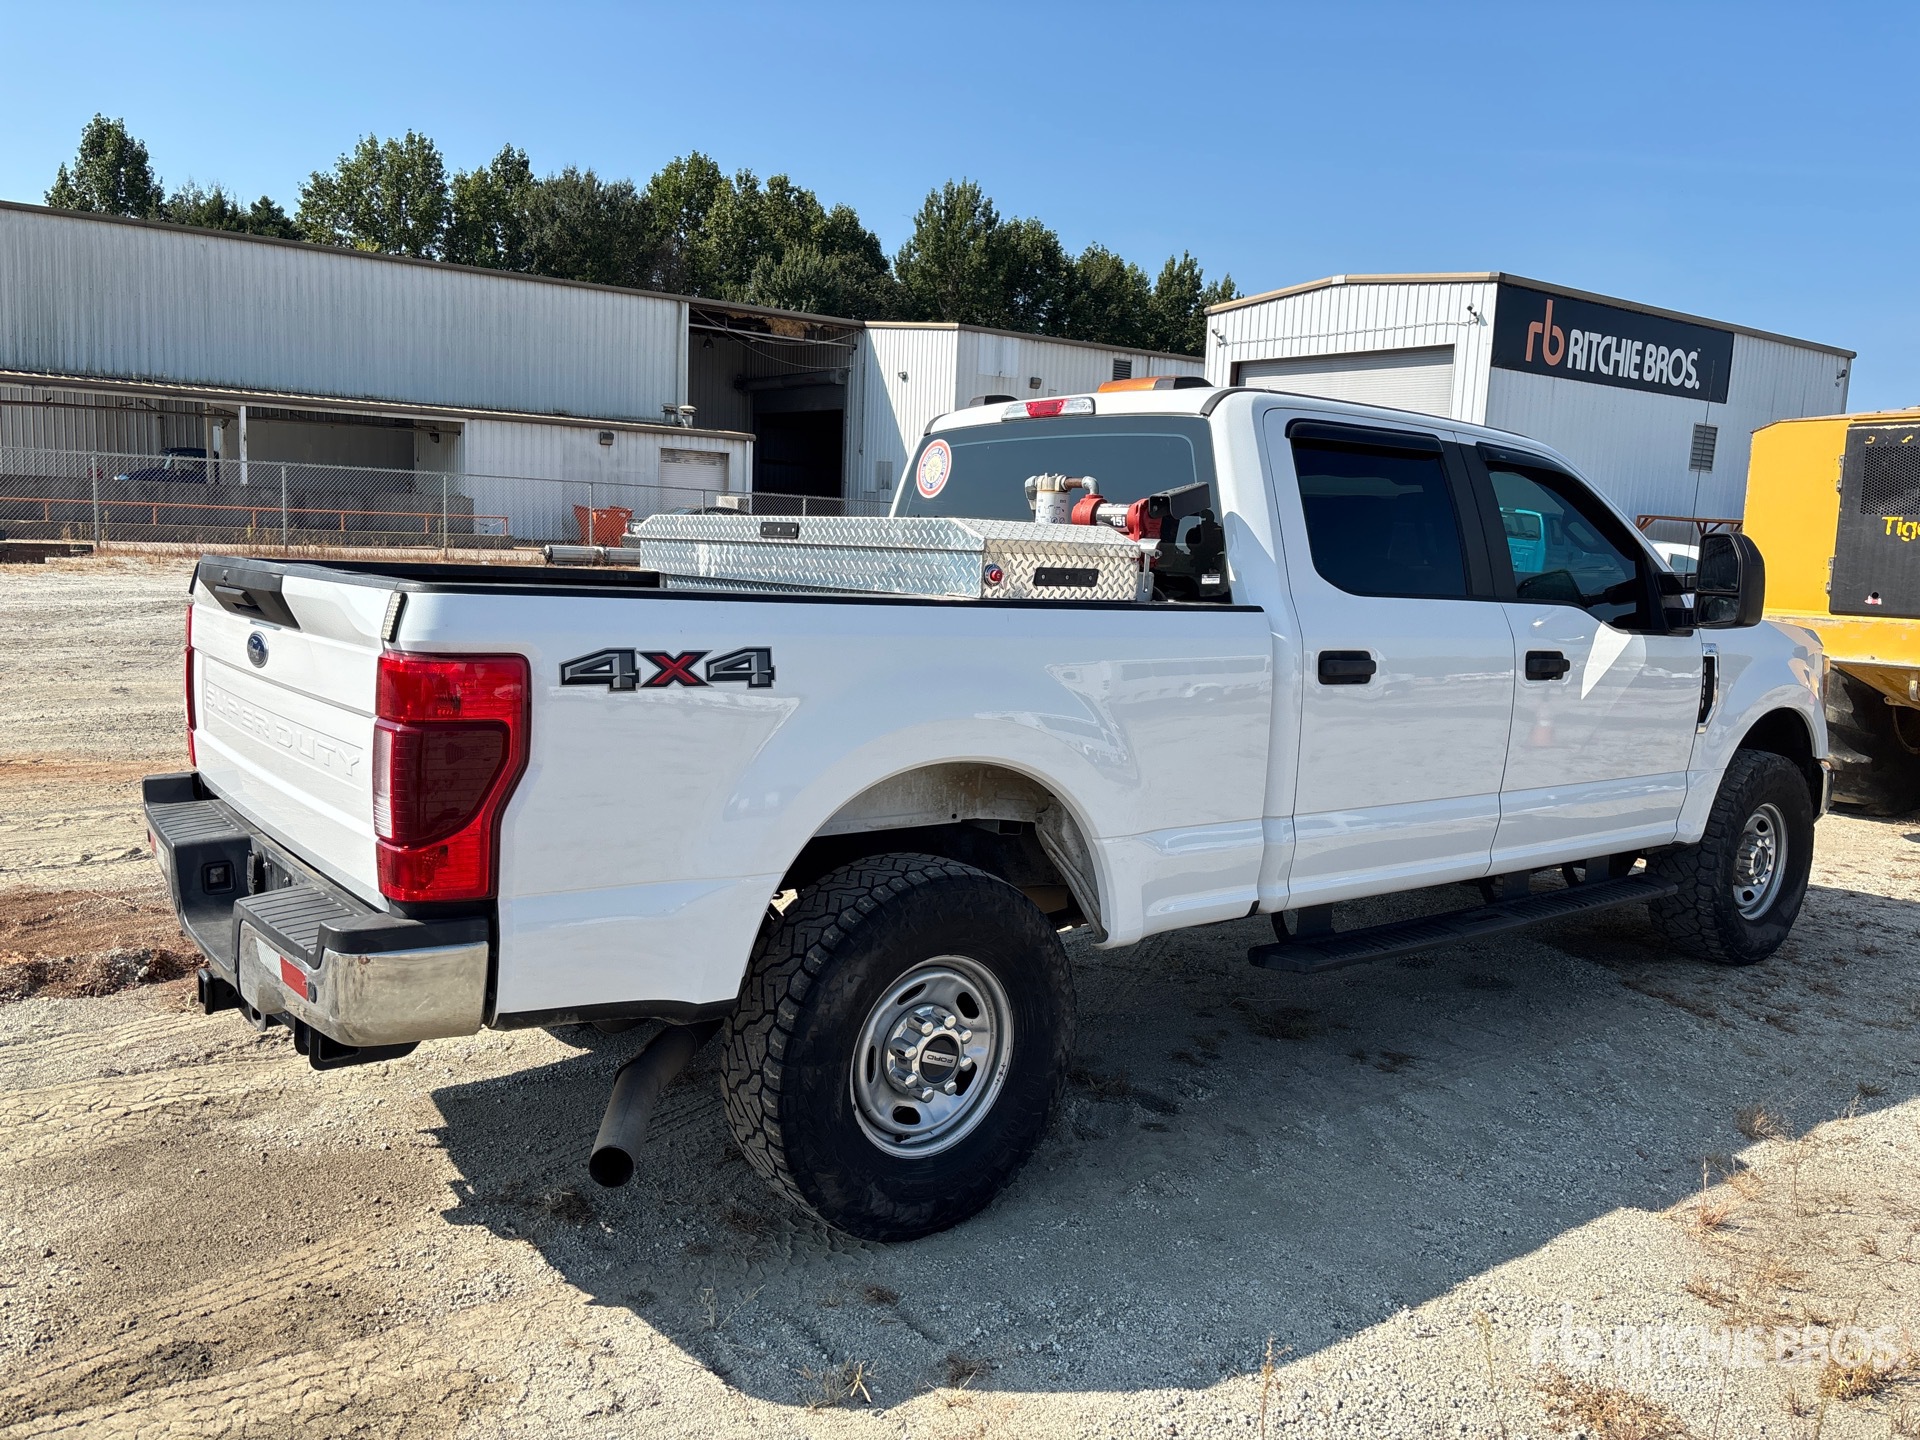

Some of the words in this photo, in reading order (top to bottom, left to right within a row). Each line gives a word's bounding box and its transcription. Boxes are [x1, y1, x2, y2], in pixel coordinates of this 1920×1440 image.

[1525, 299, 1565, 366] rb
[1567, 328, 1643, 380] RITCHIE
[1643, 343, 1700, 390] BROS.
[1110, 516, 1123, 527] 15
[206, 685, 270, 739] SUPER
[275, 722, 360, 777] DUTY
[926, 1054, 954, 1064] FORD
